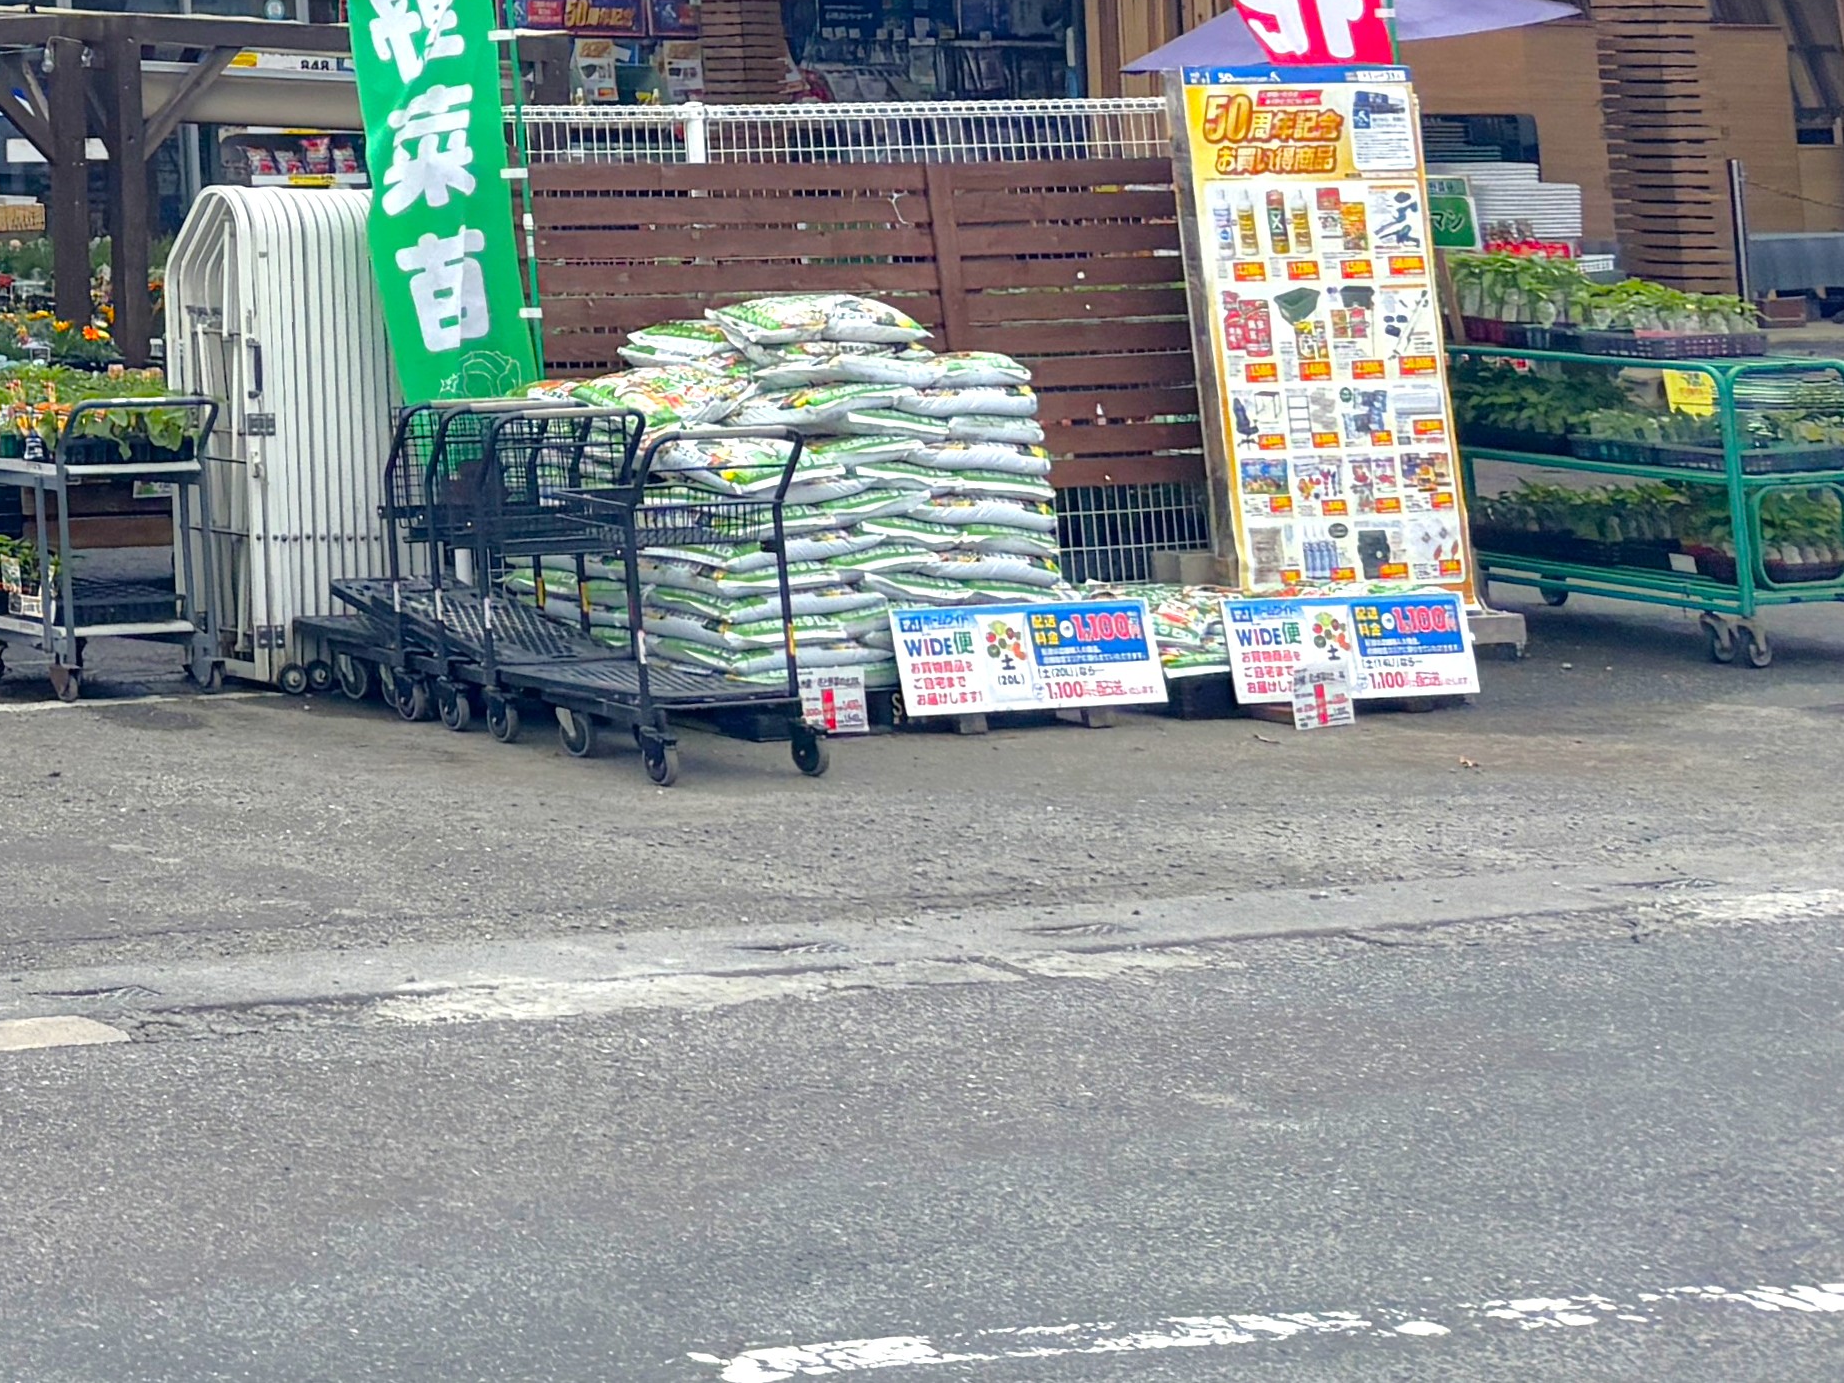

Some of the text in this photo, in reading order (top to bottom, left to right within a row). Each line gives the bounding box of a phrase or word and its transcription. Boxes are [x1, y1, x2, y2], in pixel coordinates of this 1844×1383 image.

[1204, 94, 1345, 143] 50周年記念
[1216, 145, 1338, 175] お買い得商品
[903, 631, 975, 658] WIDE便
[1235, 621, 1302, 648] WIDE便
